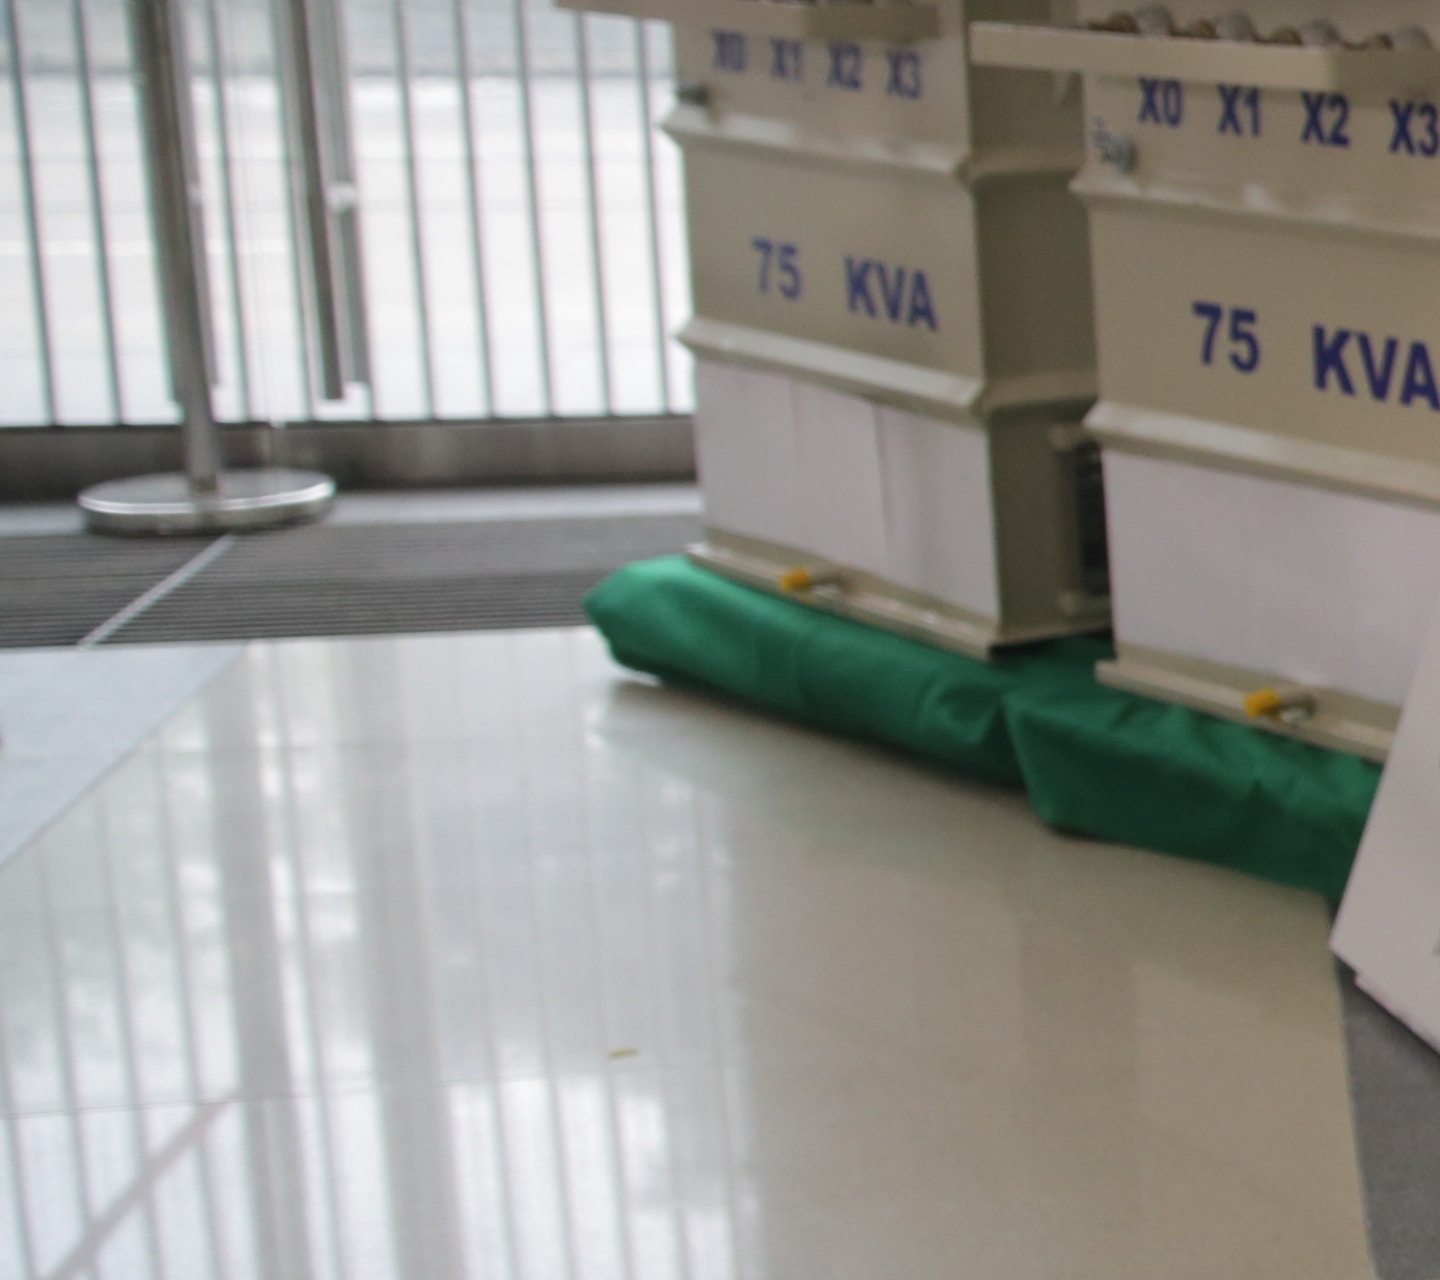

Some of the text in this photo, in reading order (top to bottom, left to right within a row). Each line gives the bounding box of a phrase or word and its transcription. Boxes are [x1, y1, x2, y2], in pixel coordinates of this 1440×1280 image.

[769, 36, 804, 83] X1
[826, 41, 863, 91] X2
[885, 46, 924, 100] X3
[1138, 76, 1440, 158] X0 X1 X2 X3
[751, 237, 941, 332] 75 KVA
[1191, 301, 1261, 375] 75
